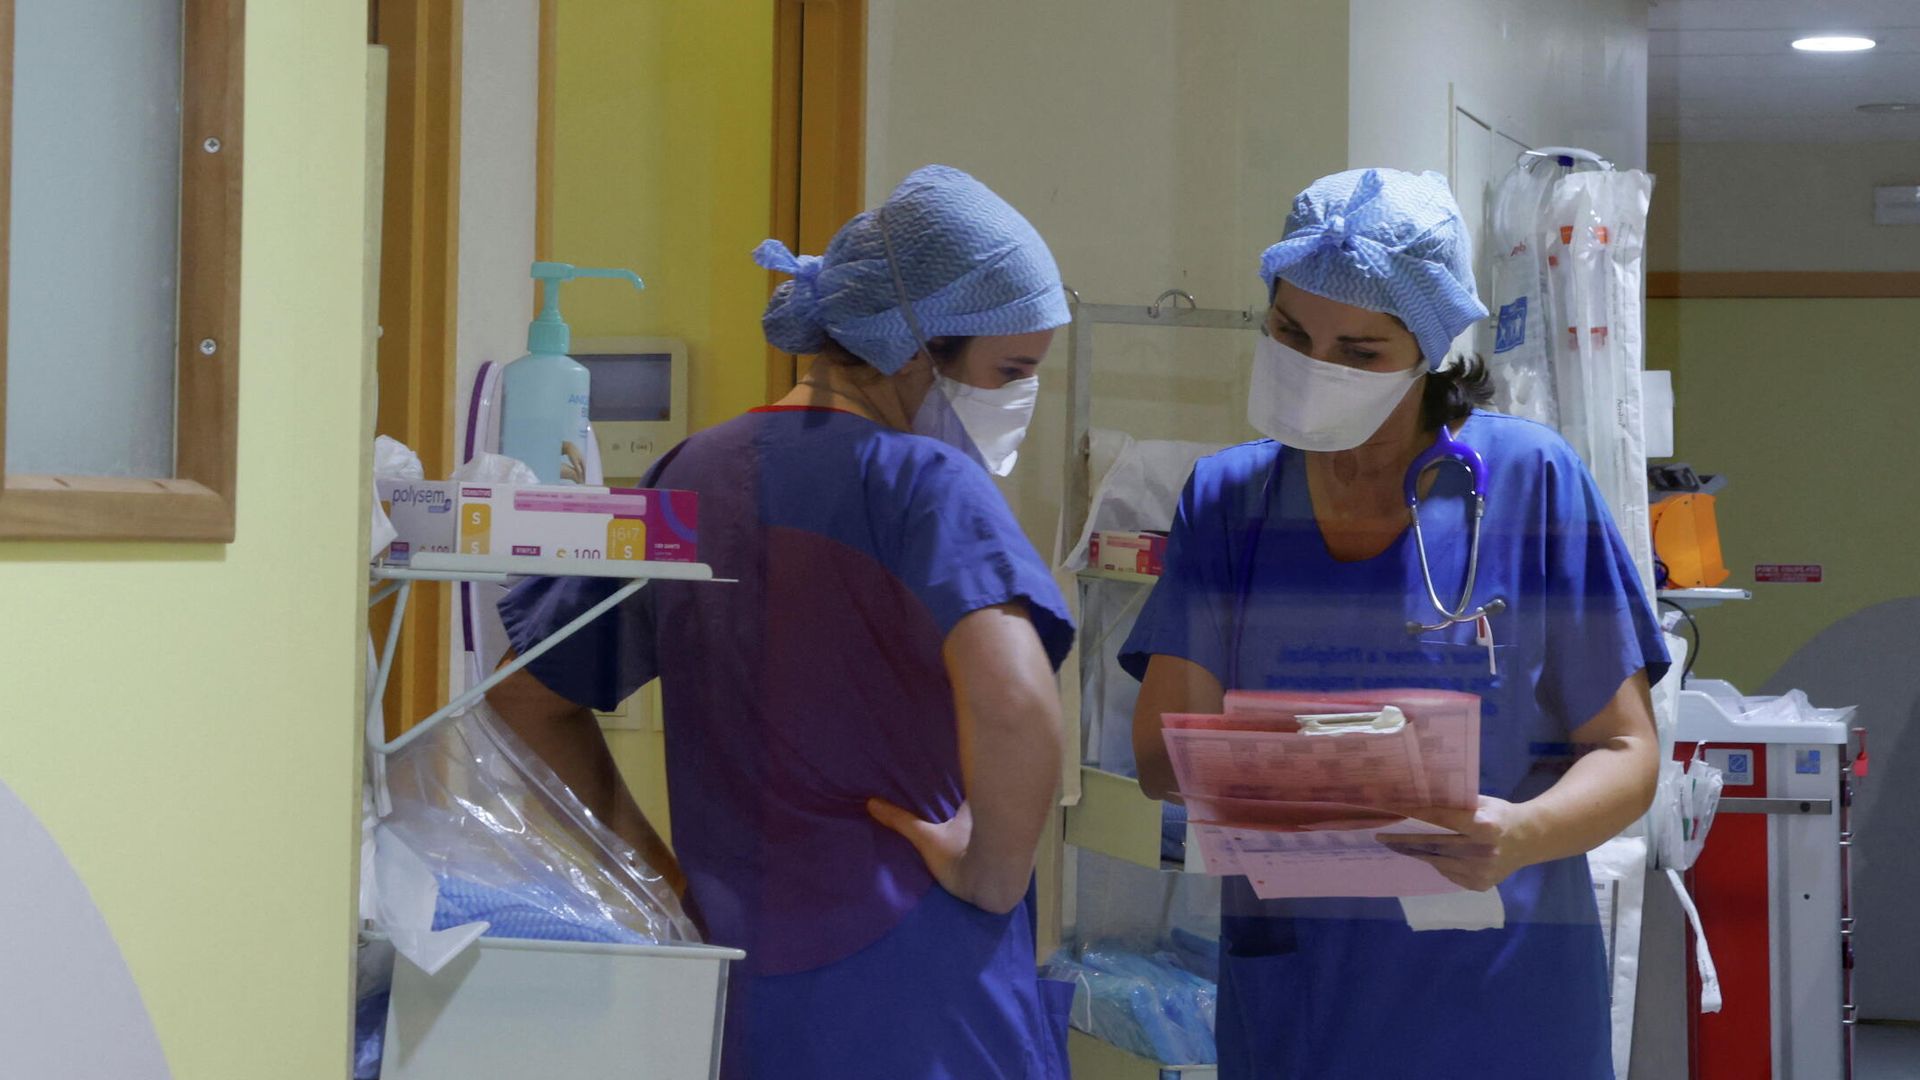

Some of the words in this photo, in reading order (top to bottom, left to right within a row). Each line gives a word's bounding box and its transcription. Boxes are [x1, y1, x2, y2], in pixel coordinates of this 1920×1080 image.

[392, 485, 445, 507] polysem
[471, 512, 481, 525] S
[471, 542, 480, 554] S
[623, 545, 633, 559] S
